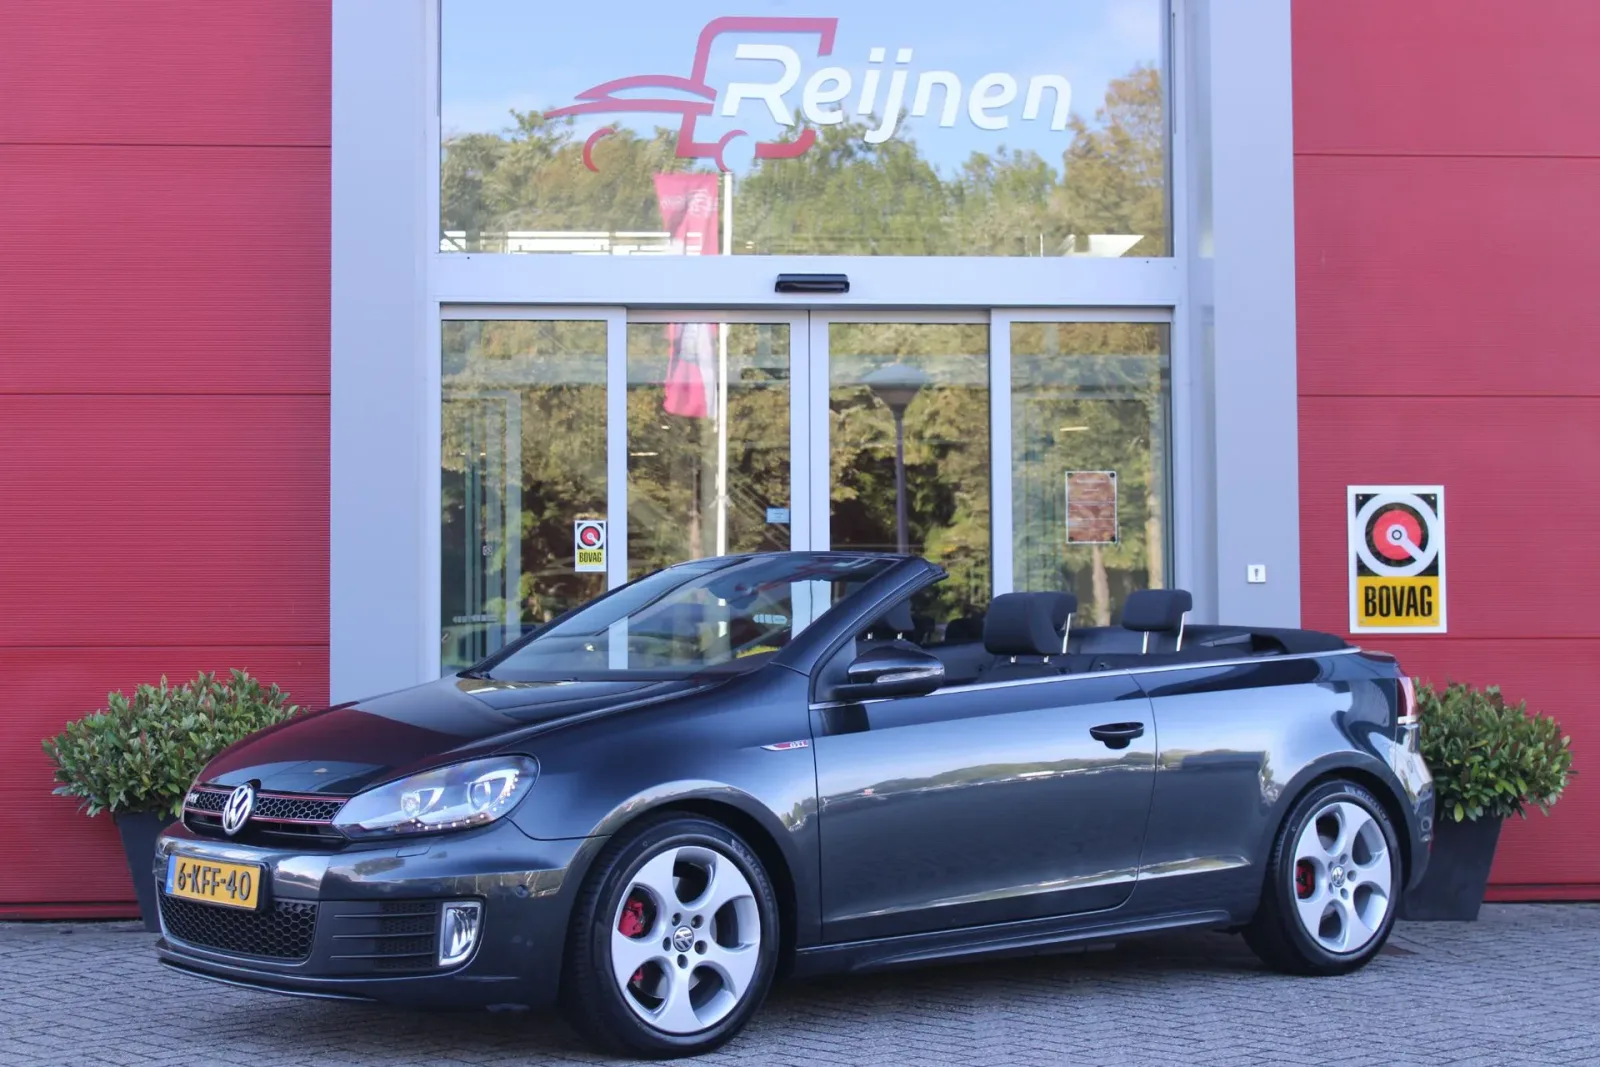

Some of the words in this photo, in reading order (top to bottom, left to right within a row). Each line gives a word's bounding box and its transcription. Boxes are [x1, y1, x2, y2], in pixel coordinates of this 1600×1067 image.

[721, 44, 1071, 144] Reijnen
[579, 552, 602, 563] BOVAG
[1364, 585, 1432, 617] BOVAG
[177, 862, 251, 901] 6-KFF-40
